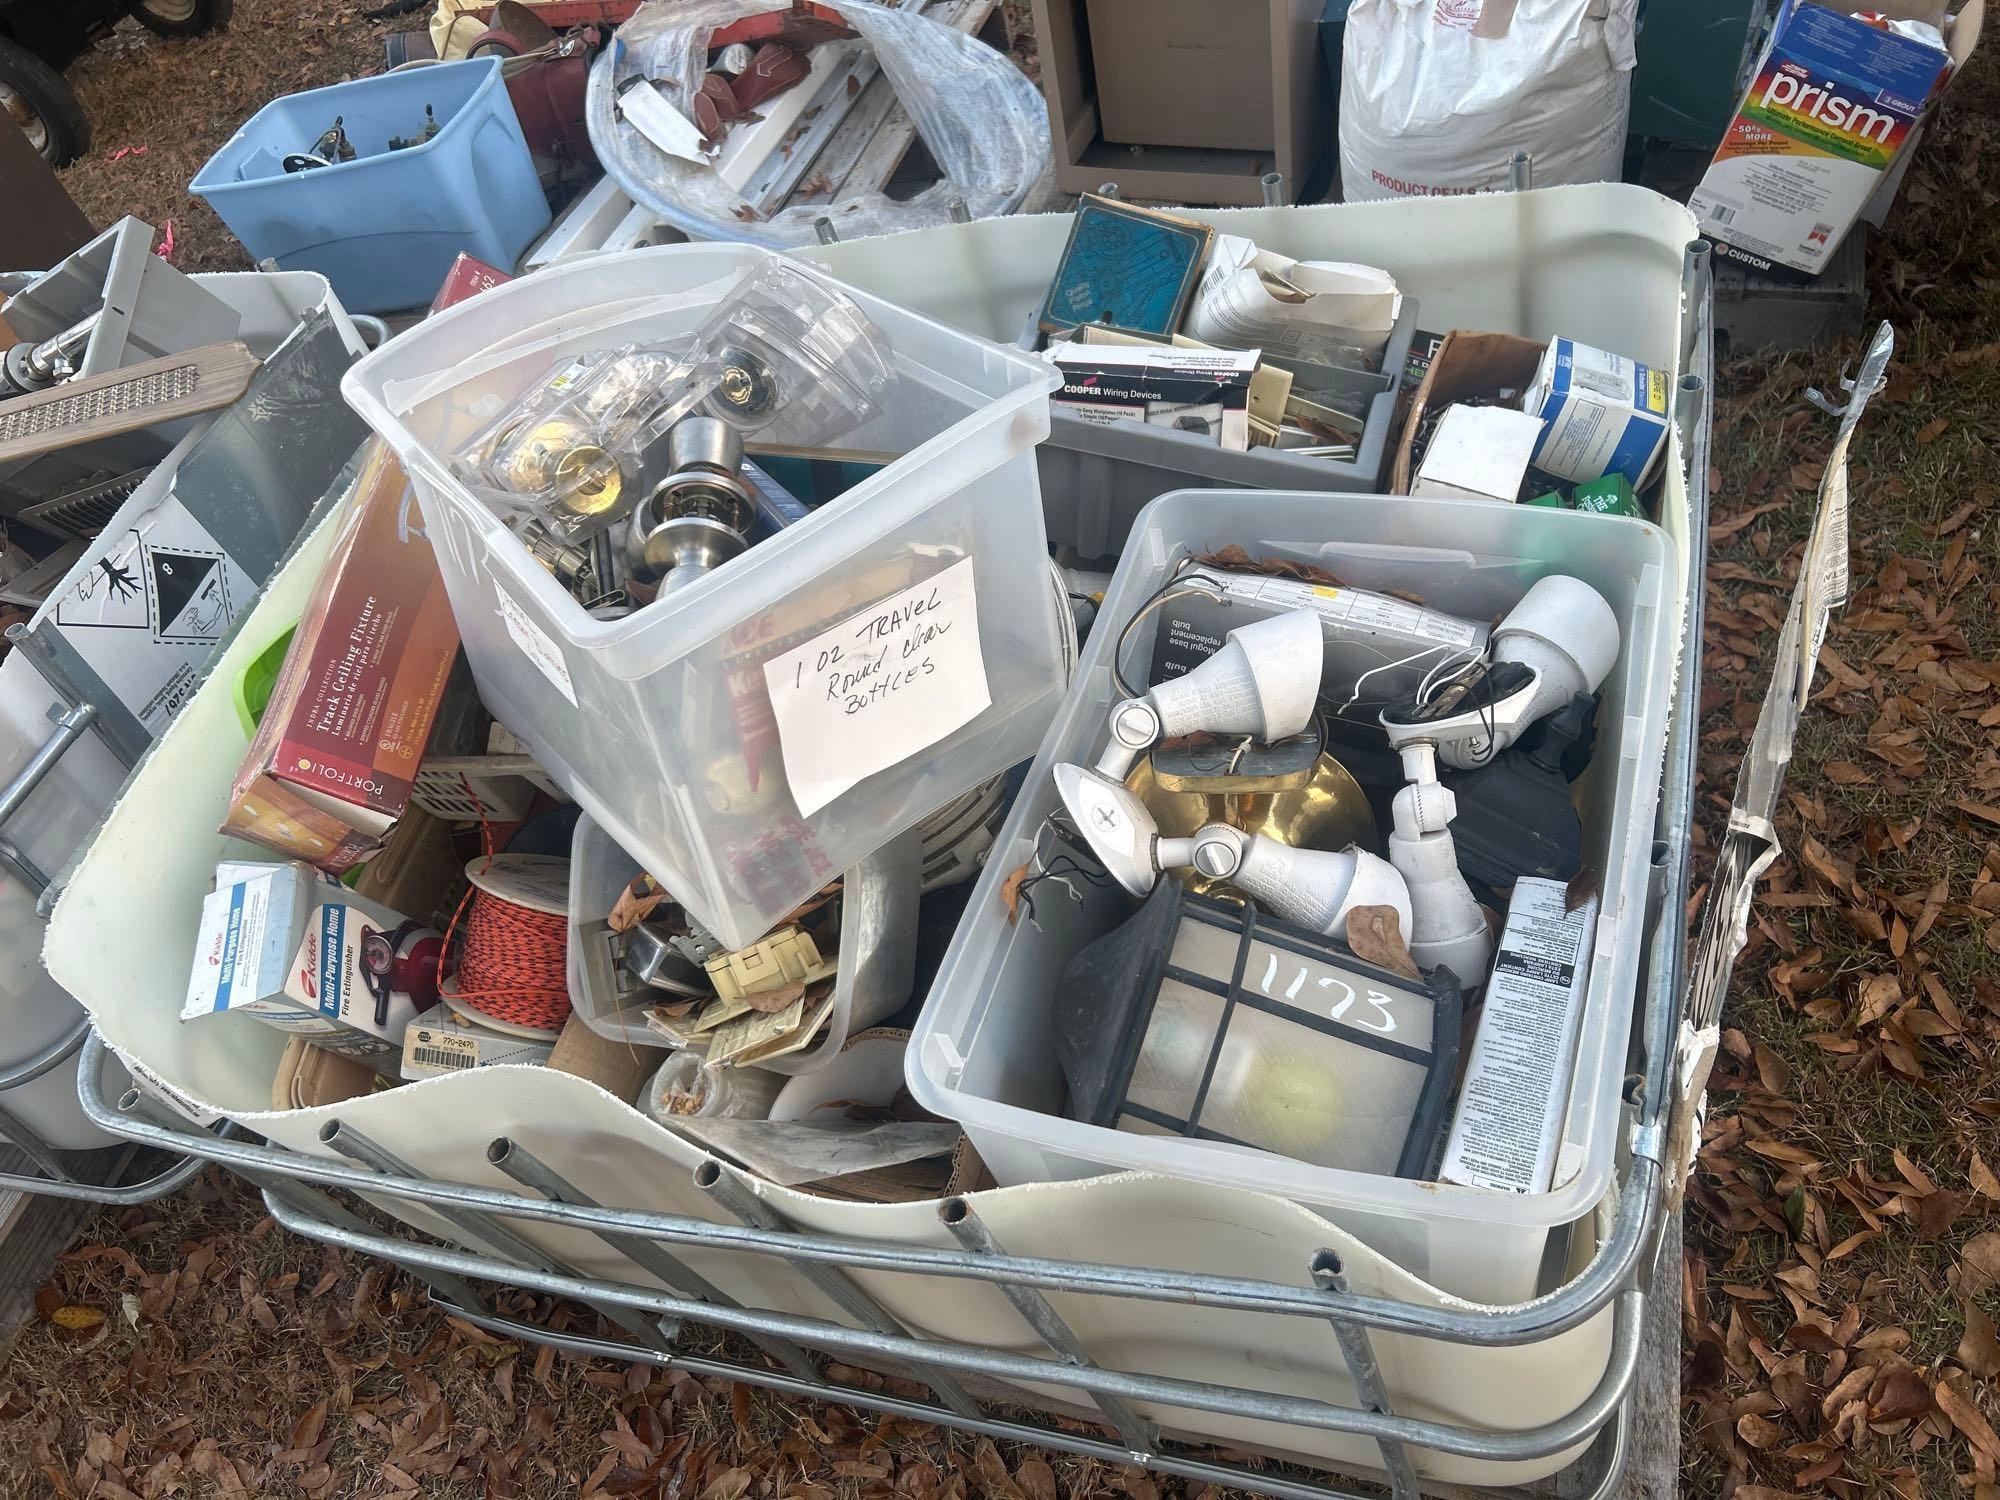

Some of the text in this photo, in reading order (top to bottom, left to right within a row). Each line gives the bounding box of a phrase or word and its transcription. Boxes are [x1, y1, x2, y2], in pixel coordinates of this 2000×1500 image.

[1760, 71, 1895, 144] prism
[1890, 98, 1916, 112] GROUT
[1745, 133, 1773, 141] MORE
[1372, 170, 1428, 197] PRODUCT
[1728, 249, 1771, 271] CUSTOM
[470, 275, 479, 287] ITEM
[1066, 281, 1089, 297] Quality
[1069, 290, 1092, 304] Piston
[1072, 300, 1093, 312] Rings
[1064, 385, 1162, 400] COOPER Wiring Devices
[1593, 495, 1609, 512] THE
[162, 562, 173, 575] 8
[1171, 618, 1191, 630] bulb
[1167, 636, 1216, 655] Mogul base
[1169, 626, 1221, 647] replacement
[315, 596, 376, 734] Track Ceiling Fixture
[330, 612, 382, 737] Luminaria de riel para el techo
[827, 644, 888, 701] Round
[1165, 661, 1187, 674] bulb
[305, 657, 337, 728] INDRA COLLECTION
[384, 711, 398, 738] FRAGILE
[298, 757, 384, 795] PORTFOLIO
[211, 931, 223, 957] Kidde
[221, 905, 241, 985] Multi-Purpose Home
[306, 932, 318, 978] Kidde
[323, 907, 340, 1010] Multi-Purpose Home
[341, 944, 355, 1017] Fire Extinguisher
[1261, 953, 1397, 1032] 1173
[442, 1036, 475, 1050] 770-2470
[1488, 1181, 1510, 1191] WARNING
